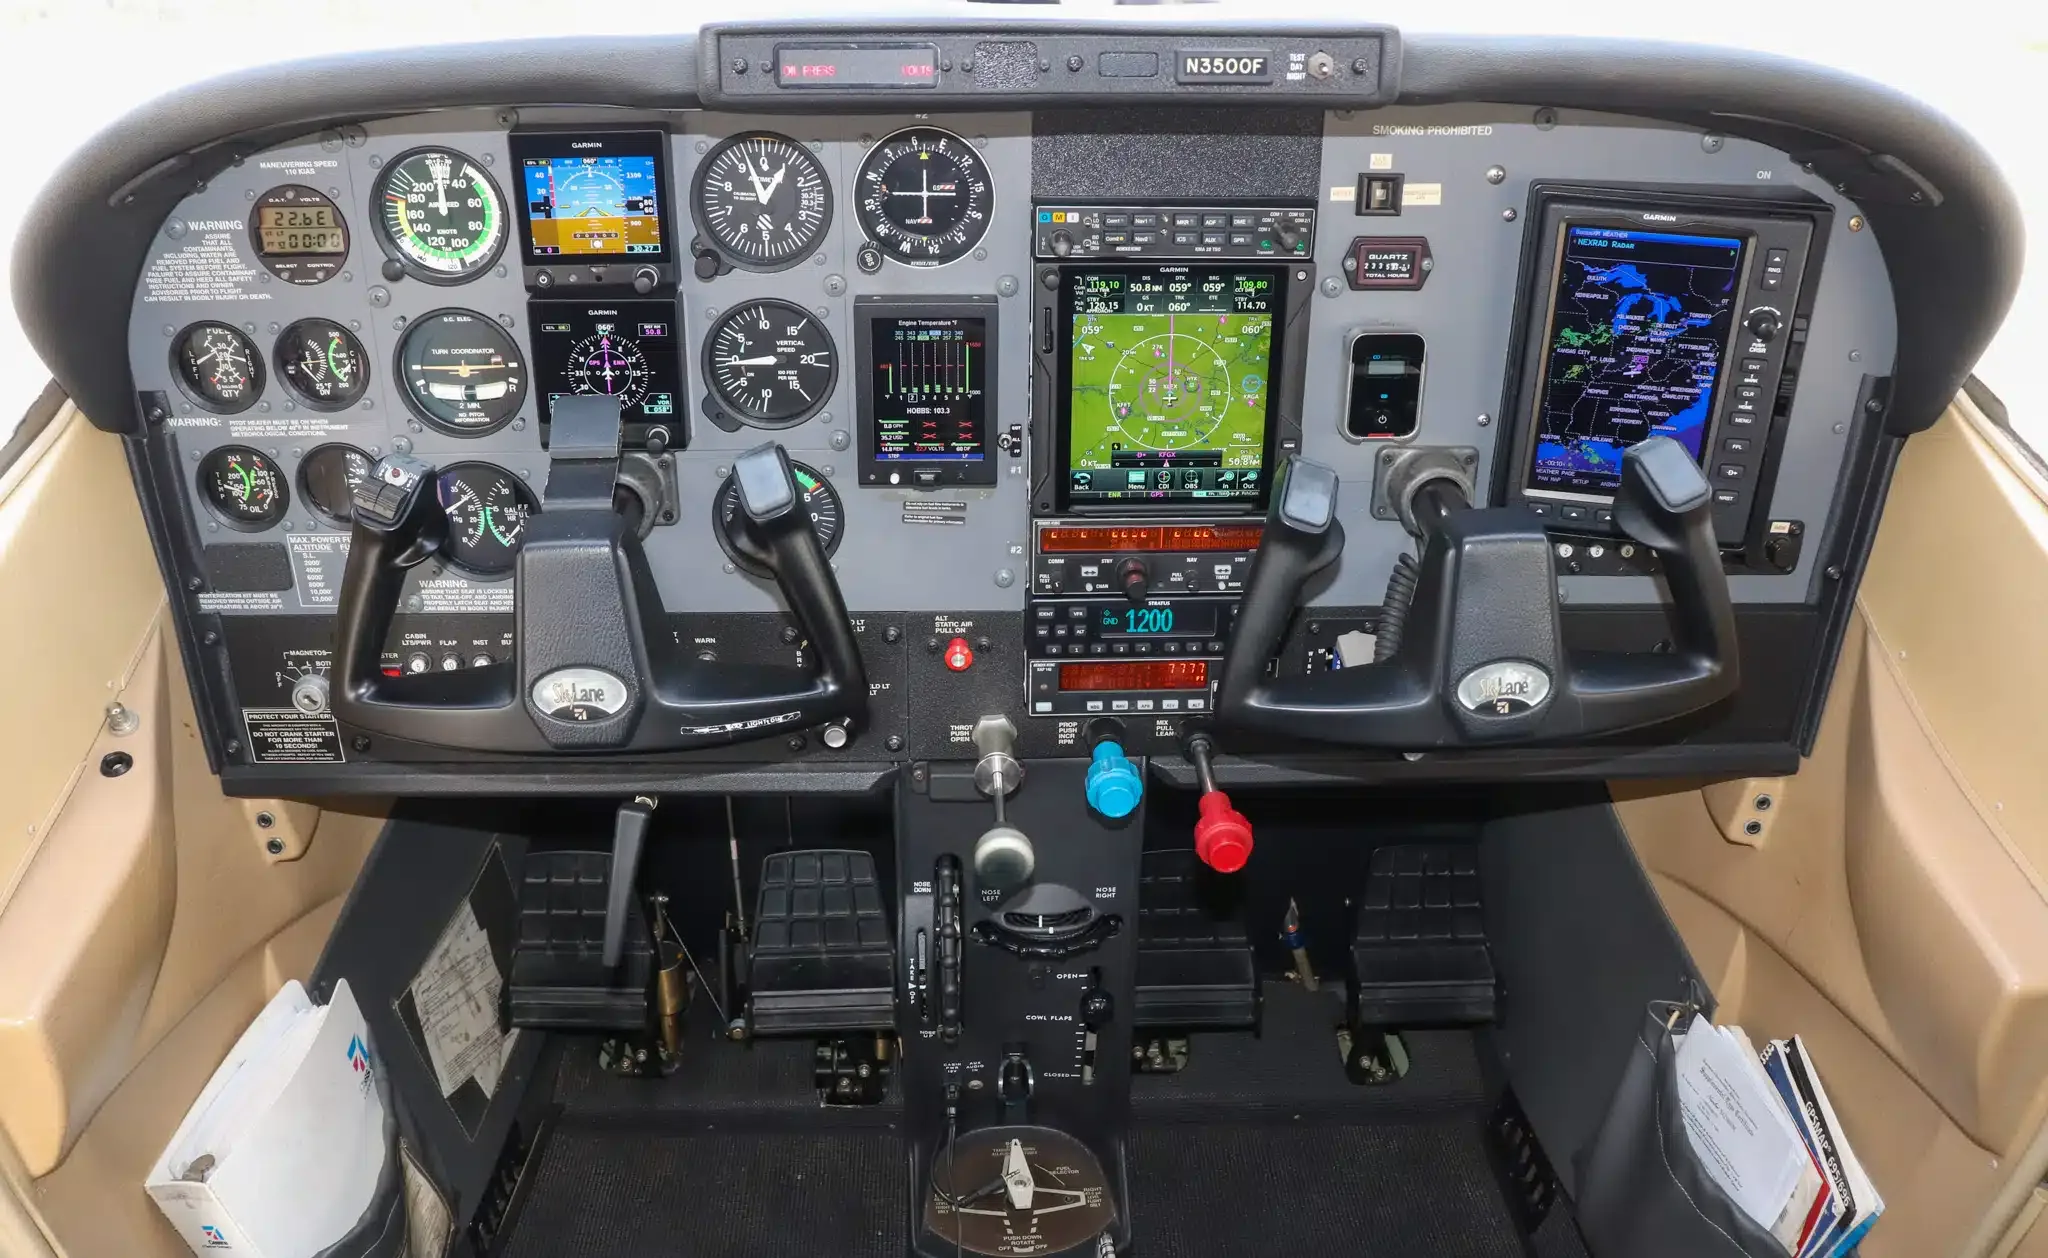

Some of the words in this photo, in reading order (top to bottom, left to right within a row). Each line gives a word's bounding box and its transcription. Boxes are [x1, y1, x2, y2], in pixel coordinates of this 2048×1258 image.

[1187, 58, 1264, 74] N3500F
[1287, 72, 1306, 80] NIGHT
[1373, 126, 1424, 136] SMOKING
[1428, 126, 1492, 136] PROHIBITED
[1756, 170, 1771, 179] ON
[412, 182, 434, 192] 200
[452, 179, 466, 188] 40
[408, 194, 425, 203] 180
[468, 199, 482, 207] 60
[407, 210, 424, 219] 160
[1643, 214, 1676, 222] GARMIN
[188, 221, 243, 230] WARNING
[413, 224, 431, 232] 140
[468, 221, 482, 230] 80
[428, 237, 445, 246] 120
[451, 238, 469, 247] 100
[1578, 239, 1608, 248] NEXRAD
[1090, 281, 1119, 289] 119.10
[1130, 283, 1151, 292] 50.8
[1169, 283, 1191, 292] 059°
[1203, 283, 1225, 292] 059°
[1238, 281, 1267, 289] 109.80
[1089, 301, 1118, 310] 120.15
[1168, 303, 1190, 311] 060°
[1237, 301, 1266, 310] 114.70
[759, 320, 770, 329] 10
[787, 327, 798, 335] 15
[1082, 325, 1104, 334] 059°
[1242, 325, 1264, 334] 060°
[800, 355, 815, 364] 20
[789, 381, 800, 389] 15
[762, 389, 772, 398] 10
[167, 418, 222, 427] WARNING:
[1011, 466, 1021, 474] #1
[1011, 546, 1022, 554] #2
[419, 580, 468, 588] WARNING
[1103, 617, 1118, 625] GND
[1125, 609, 1173, 633] 1200
[1827, 1156, 1851, 1207] 695/696
